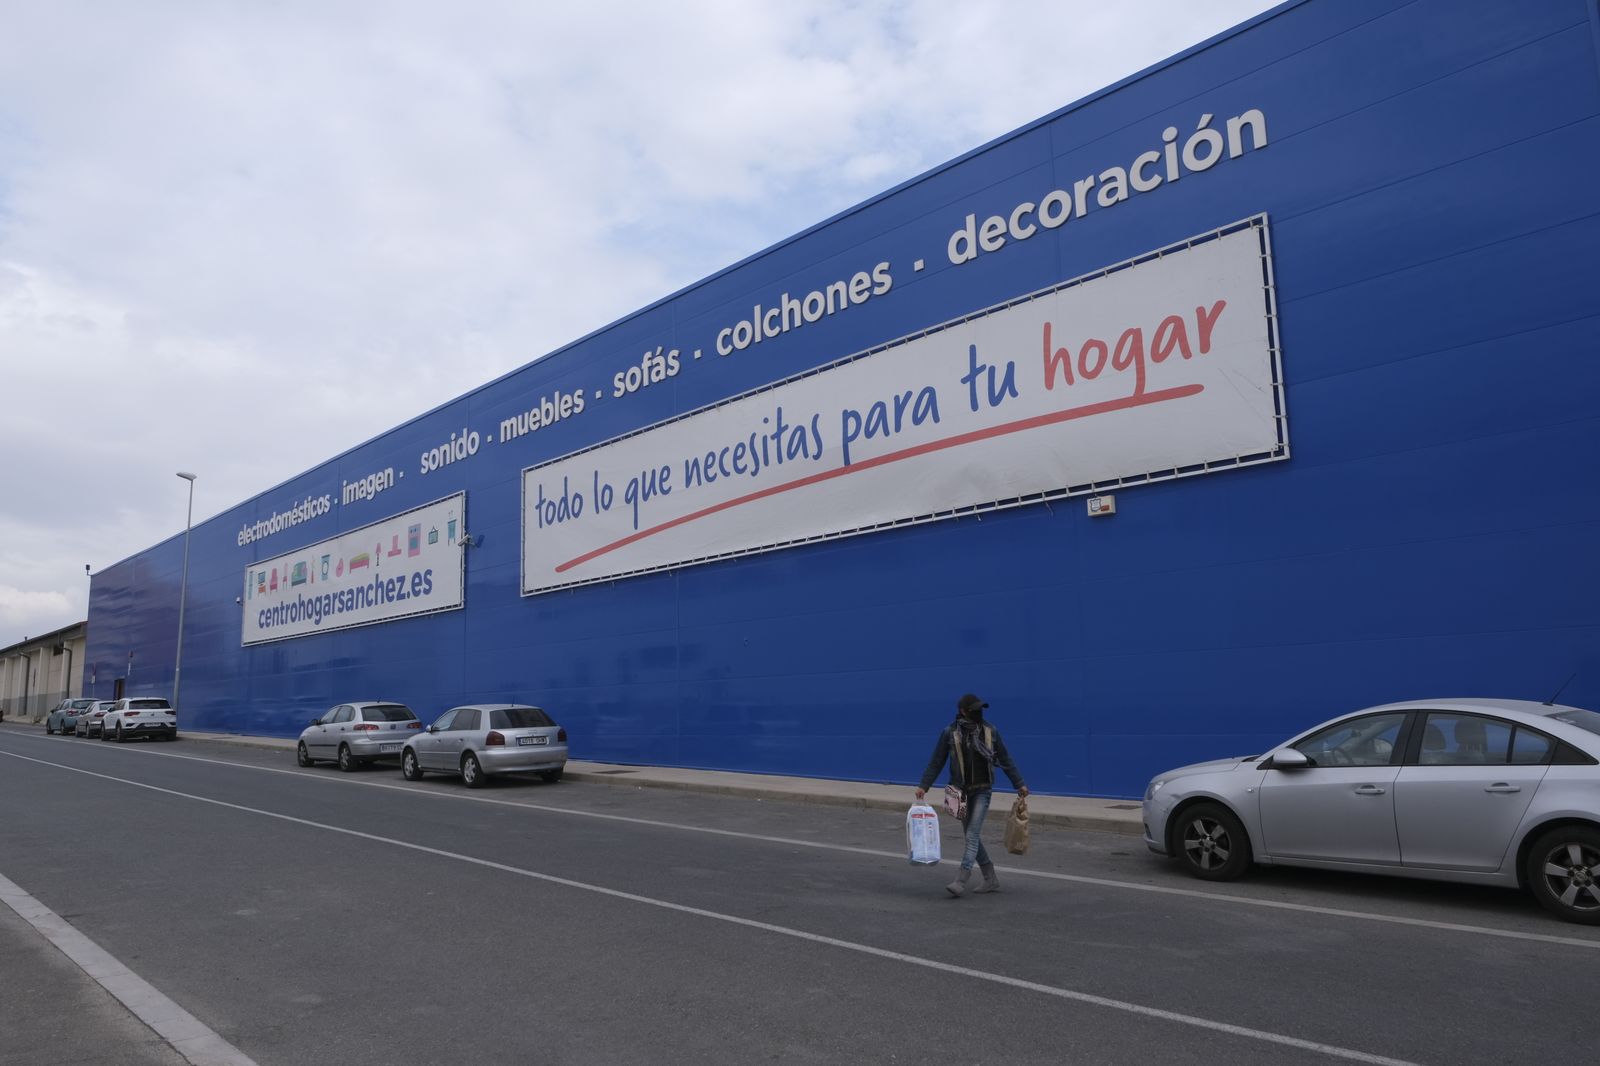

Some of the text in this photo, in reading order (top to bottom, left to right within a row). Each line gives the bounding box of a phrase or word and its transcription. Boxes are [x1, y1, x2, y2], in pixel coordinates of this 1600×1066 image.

[236, 108, 1268, 548] electrodomésticos imagen sonido muebles sofás colchones decoración
[535, 300, 1227, 529] todo lo que necesitas para tu hogar
[258, 569, 434, 629] centrohogarsanchez.es
